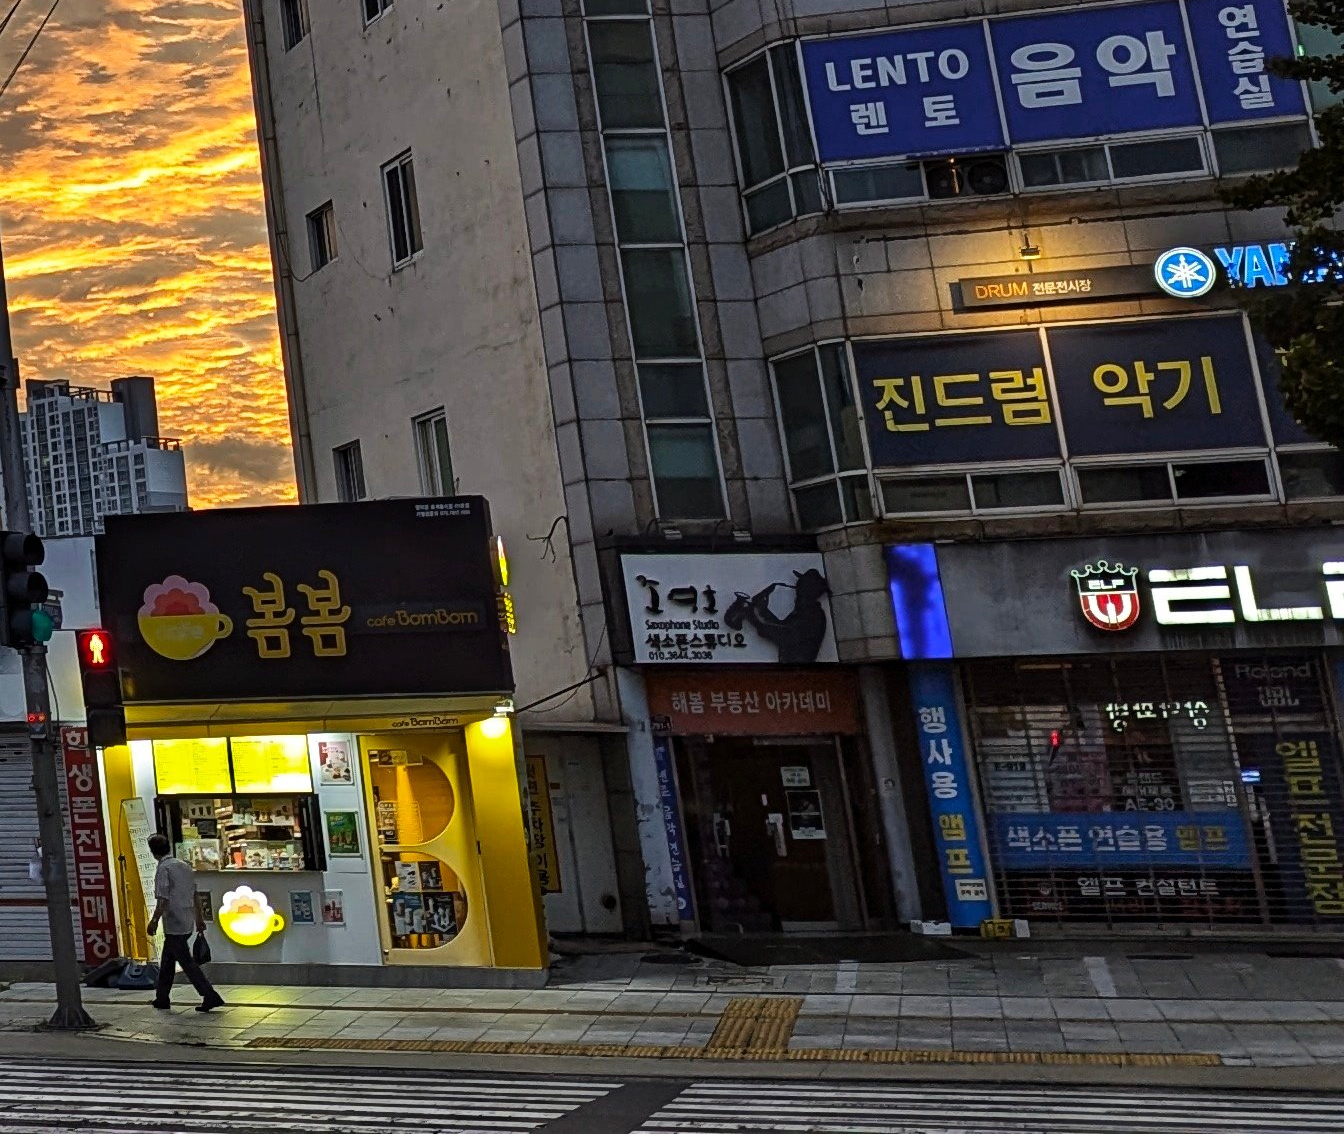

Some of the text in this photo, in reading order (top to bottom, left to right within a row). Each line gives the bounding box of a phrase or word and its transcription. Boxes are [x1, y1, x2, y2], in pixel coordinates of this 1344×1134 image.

[825, 48, 970, 93] LENTO
[1010, 30, 1177, 109] 음악
[1217, 4, 1274, 110] 연습실
[975, 278, 1092, 300] DRUM 전문전시장
[872, 356, 1222, 432] 진드럼 악기
[1088, 579, 1126, 590] ELF
[1148, 561, 1344, 626] EL
[242, 569, 352, 659] 봄봄
[367, 608, 479, 628] cafe BomBom
[645, 618, 720, 632] Saxophone Studio
[646, 633, 748, 652] 색소폰스튜디오
[671, 689, 832, 714] 해봄 부동산 아카데미
[410, 716, 460, 728] BomBom
[917, 705, 974, 875] 행사용 앰프
[1007, 824, 1084, 853] 색소폰
[1088, 824, 1168, 853] 연습용
[1076, 876, 1220, 897] 엘프 컨설턴트
